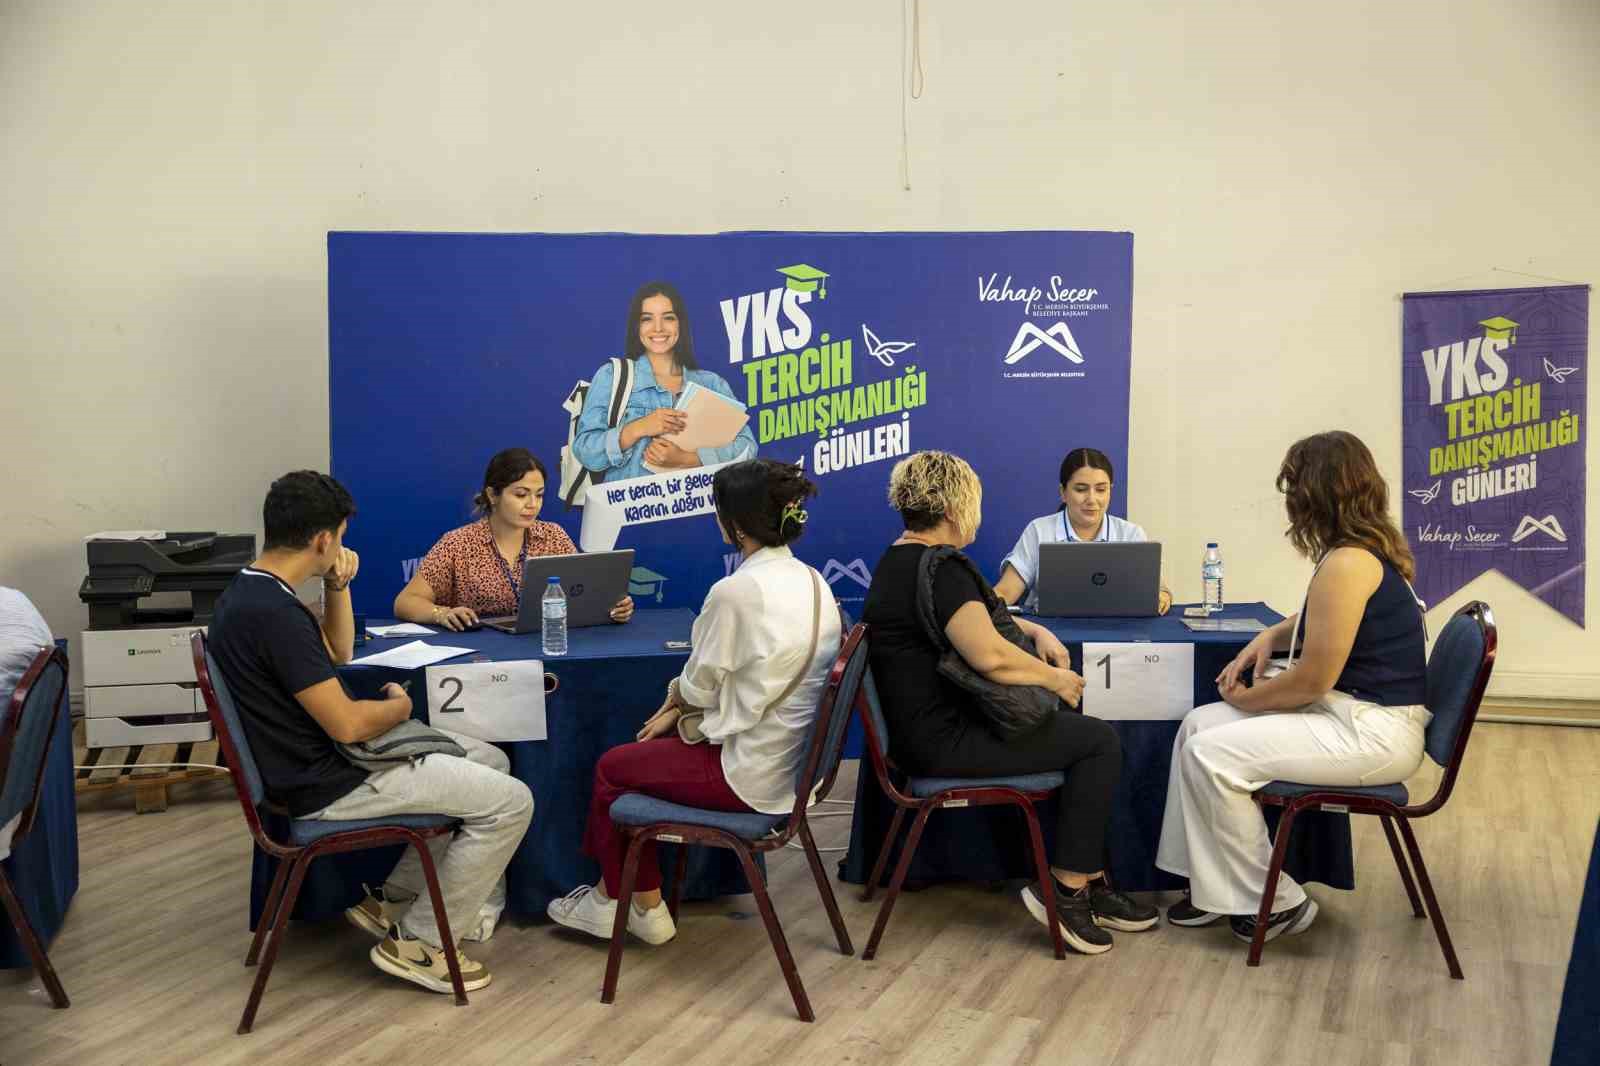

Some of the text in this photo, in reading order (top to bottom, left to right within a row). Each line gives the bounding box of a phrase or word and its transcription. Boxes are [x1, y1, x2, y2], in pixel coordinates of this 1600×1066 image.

[978, 273, 1042, 315] Vahap
[720, 287, 812, 364] YKS
[742, 333, 852, 408] TERCİH
[1421, 337, 1509, 405] YKS
[759, 365, 927, 444] DANIŞMANLIĞI
[1445, 378, 1541, 440] TERCİH
[814, 412, 910, 476] GÜNLERİ
[1430, 409, 1579, 476] DANIŞMANLIĞI
[607, 473, 715, 505] Her tercih, bir gelec
[672, 492, 704, 514] doğru
[1452, 454, 1537, 506] GÜNLERİ
[1418, 523, 1461, 550] Vahap
[439, 674, 508, 713] 2 NO
[1097, 654, 1159, 689] 1 NO
